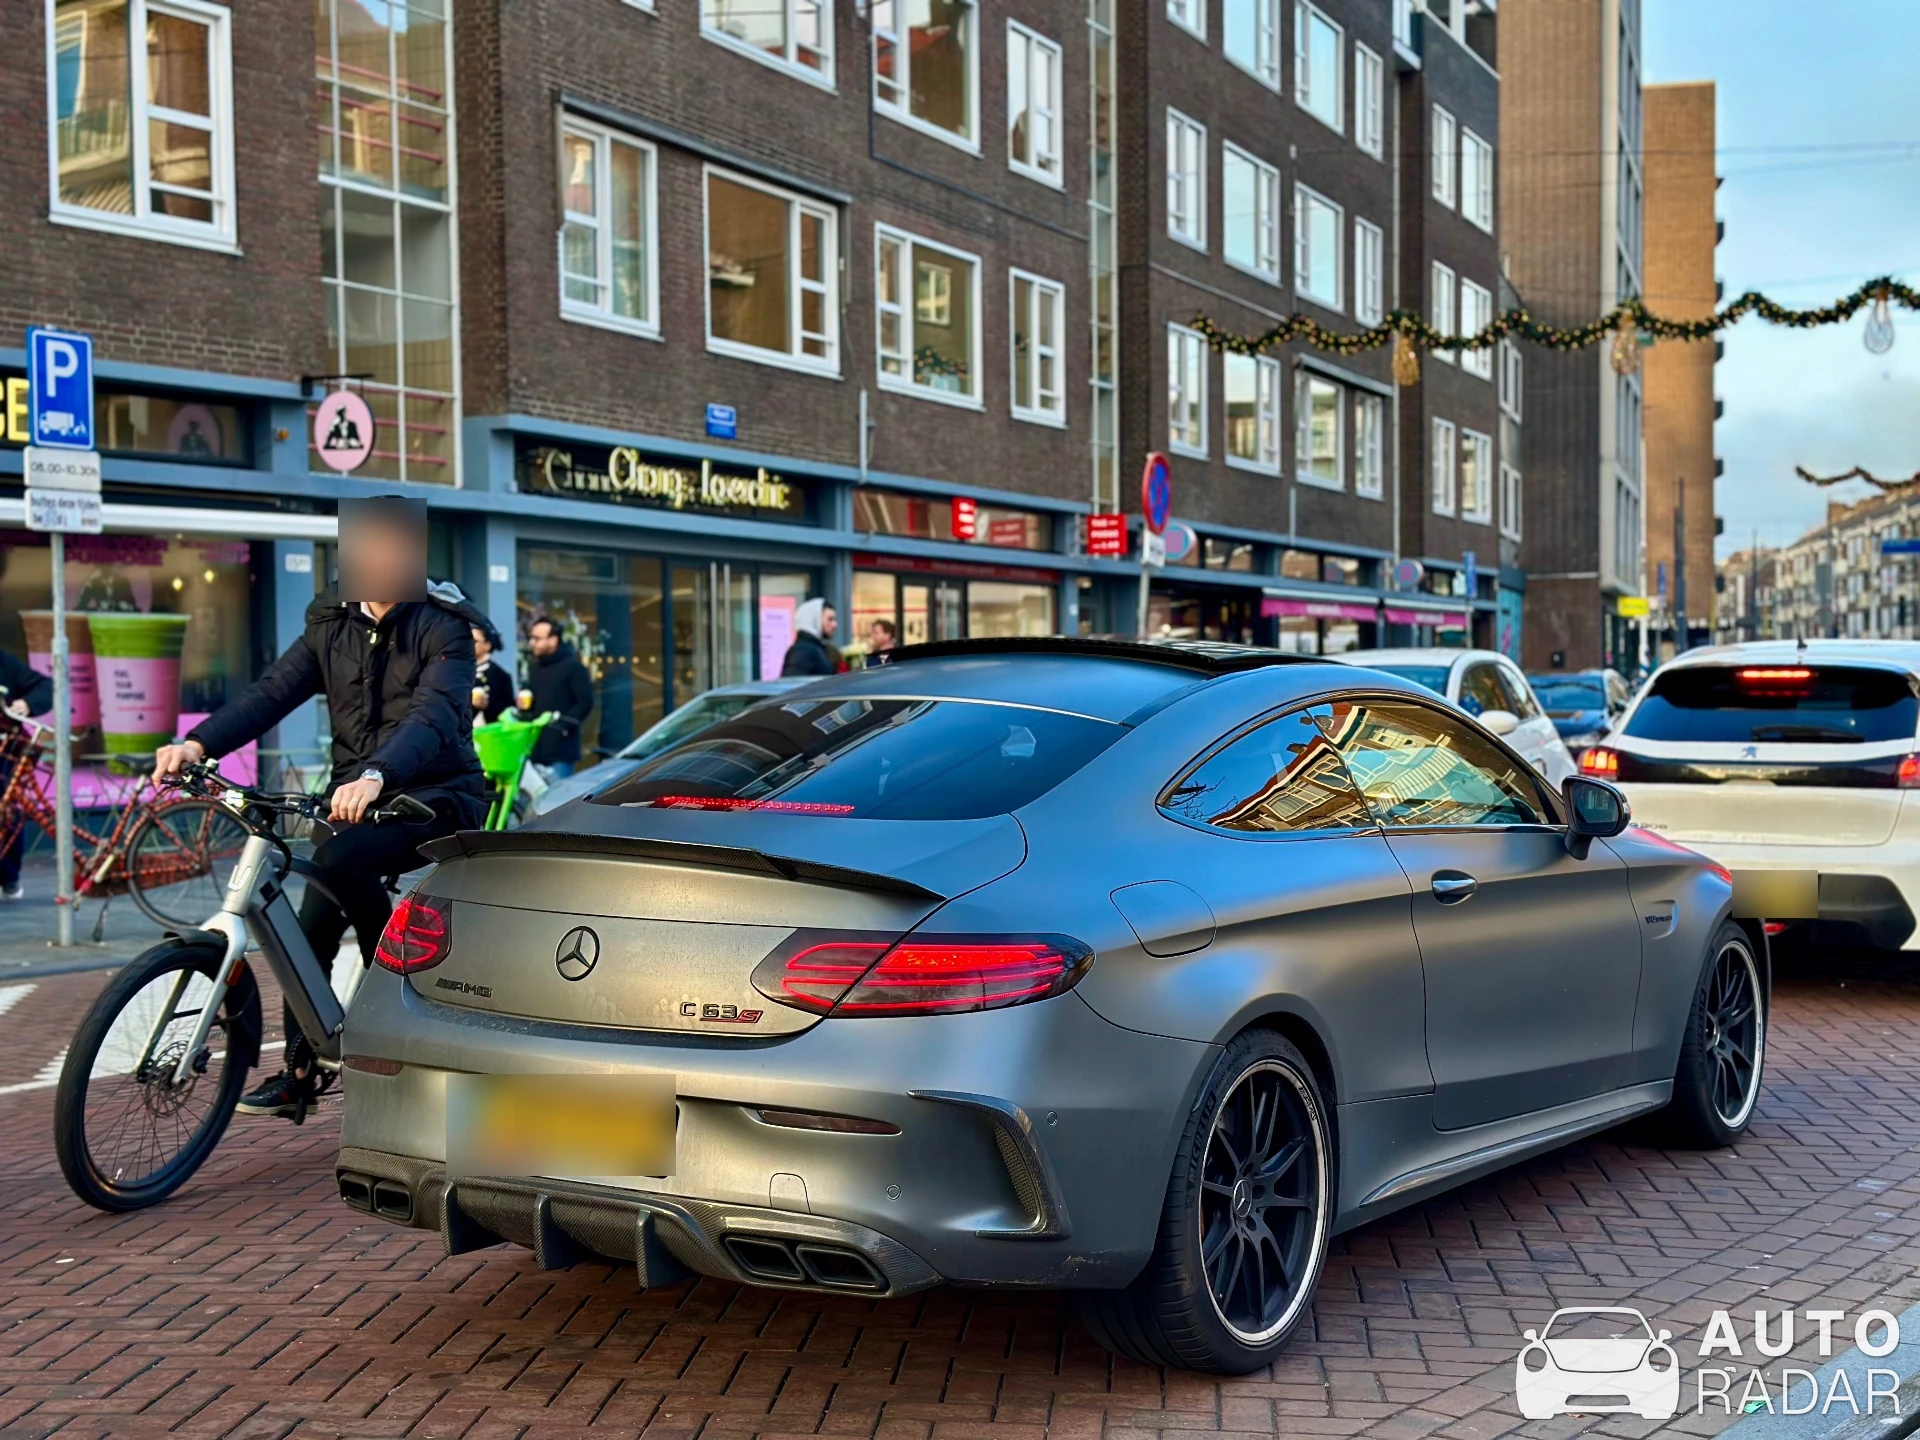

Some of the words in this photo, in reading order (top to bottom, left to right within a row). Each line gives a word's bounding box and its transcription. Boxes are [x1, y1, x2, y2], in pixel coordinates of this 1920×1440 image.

[45, 339, 79, 398] P
[0, 376, 31, 442] E
[446, 979, 492, 998] AMG
[680, 1002, 697, 1016] C
[1188, 1093, 1217, 1184] MICHELIN
